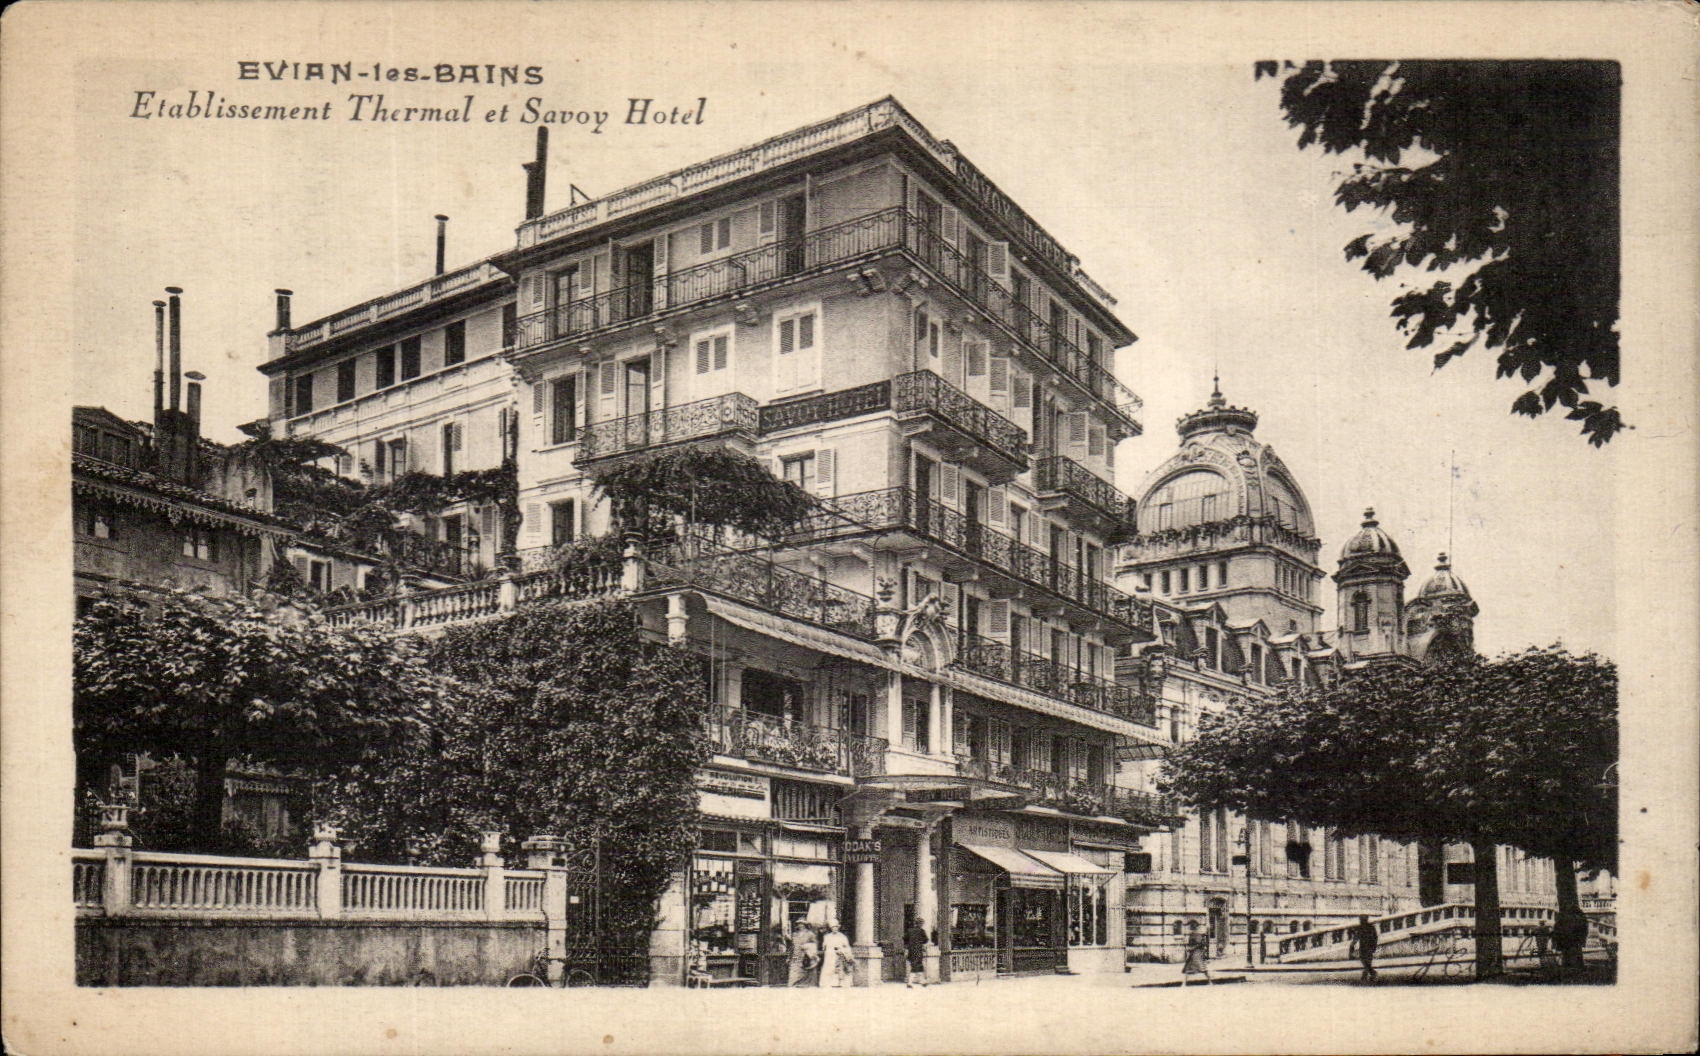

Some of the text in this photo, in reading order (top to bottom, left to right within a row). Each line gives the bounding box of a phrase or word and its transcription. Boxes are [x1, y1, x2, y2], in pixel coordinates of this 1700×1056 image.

[959, 161, 1070, 272] SAVOY HOTEL
[763, 386, 886, 430] SAVOY HOTEL
